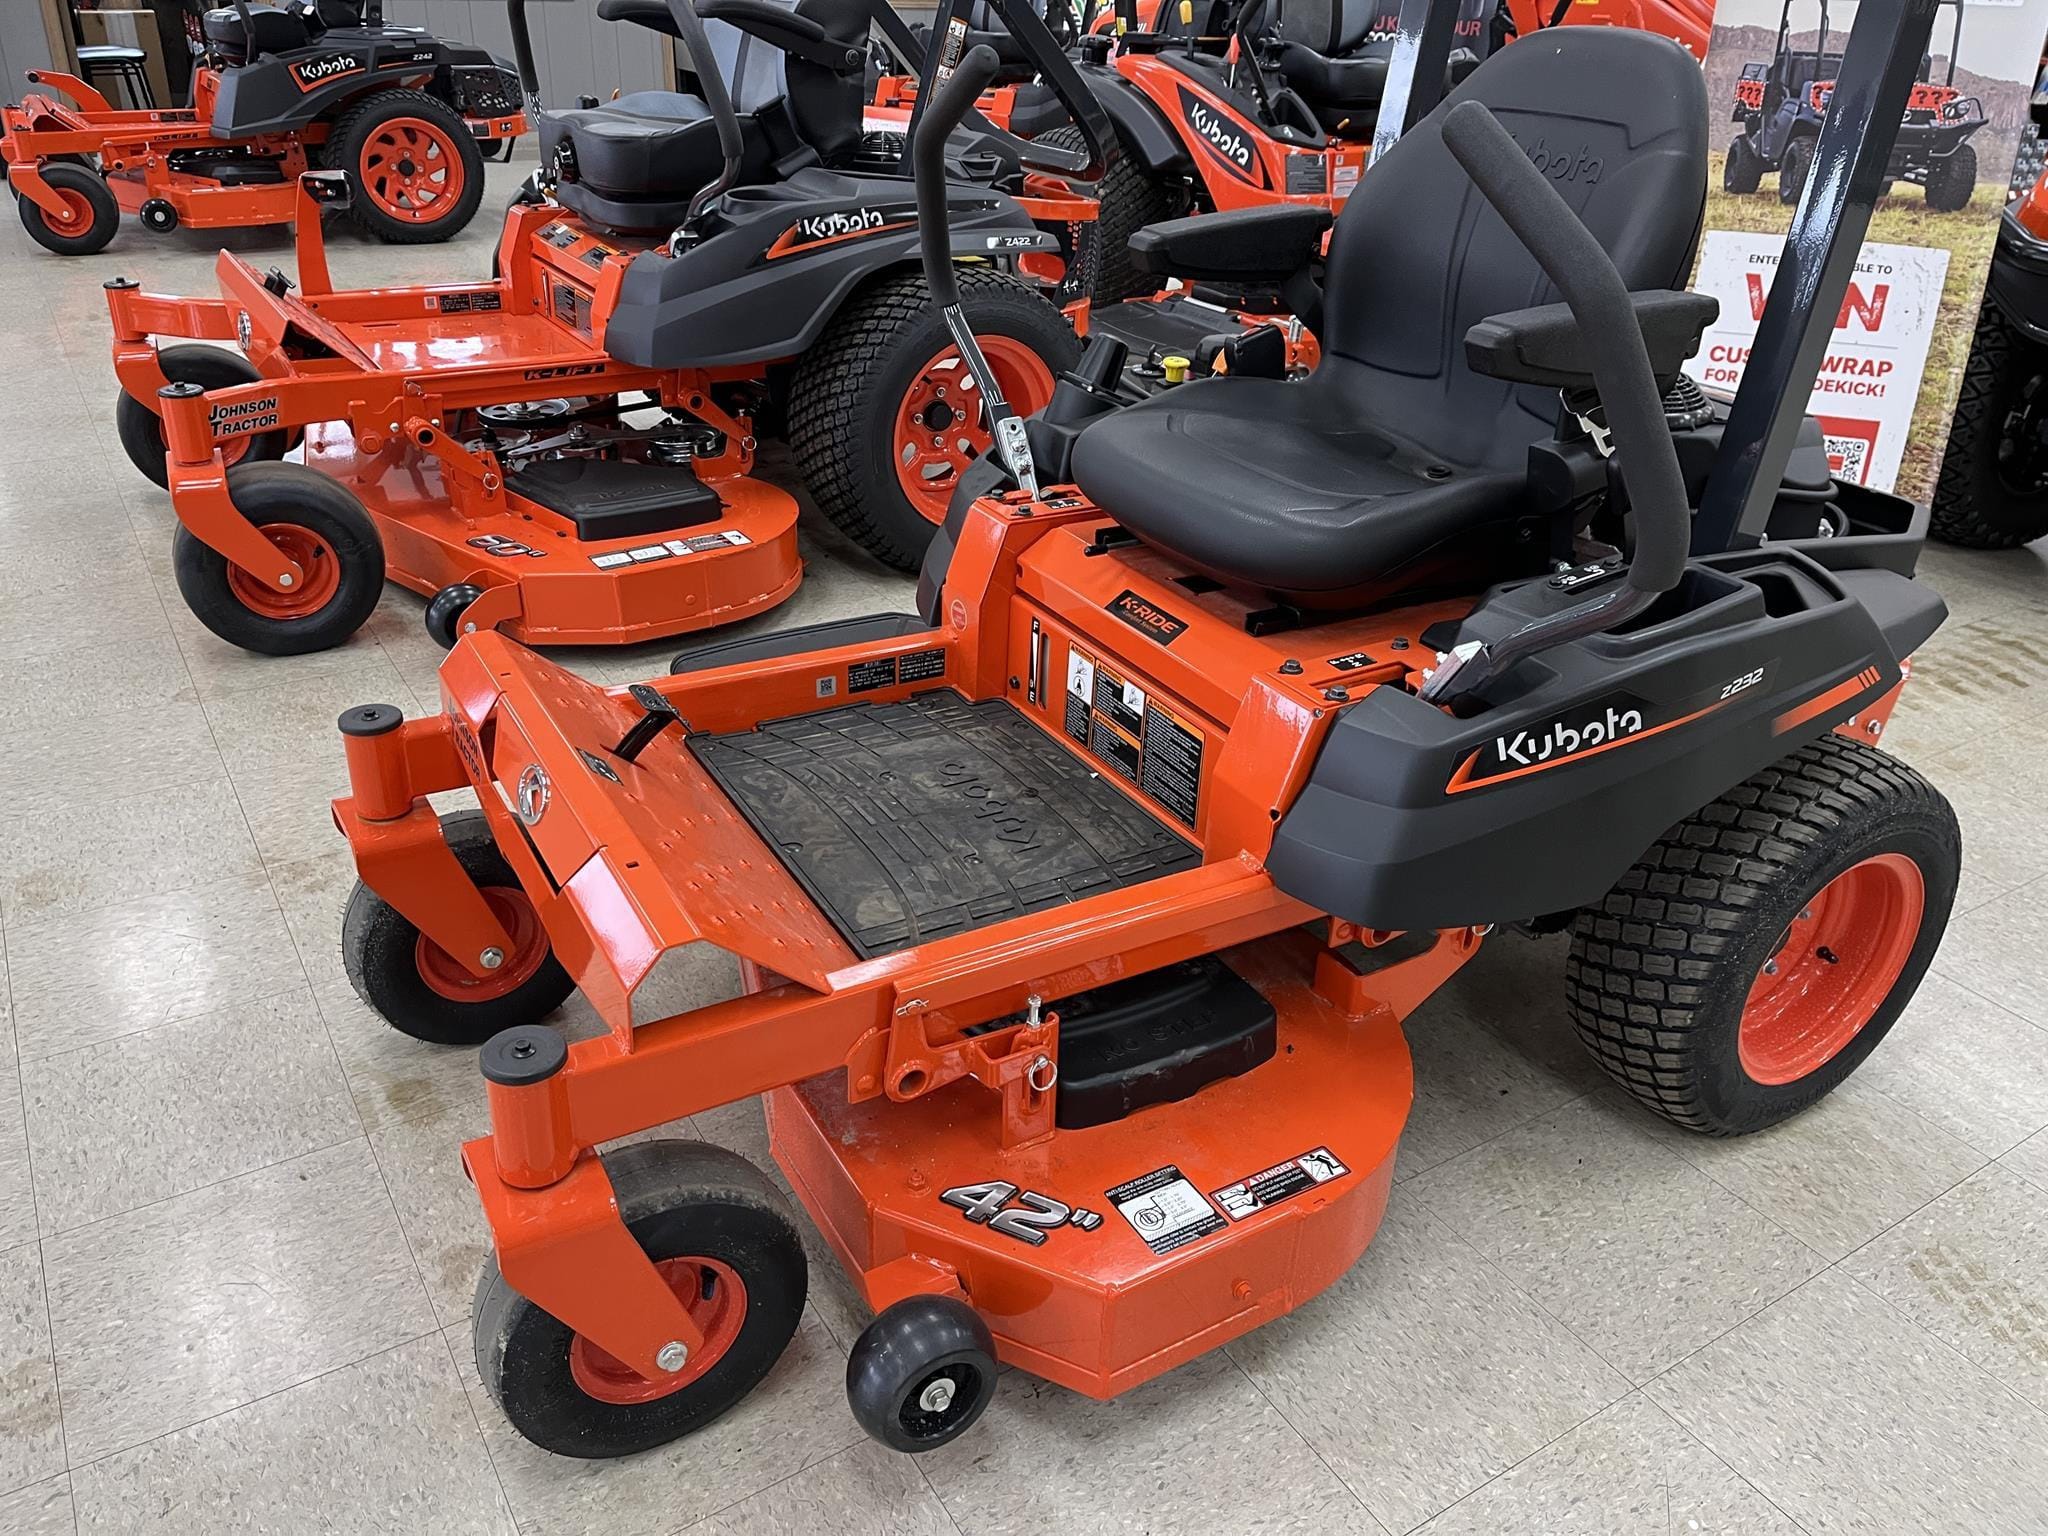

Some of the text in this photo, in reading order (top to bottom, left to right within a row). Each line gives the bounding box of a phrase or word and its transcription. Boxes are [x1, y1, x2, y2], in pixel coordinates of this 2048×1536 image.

[300, 56, 356, 79] Kubota
[1191, 102, 1249, 166] Kubota
[803, 208, 884, 238] Kubota
[1749, 254, 1780, 265] ENTE
[1877, 265, 1893, 275] TO
[526, 365, 599, 380] K-LIFT
[1821, 356, 1894, 378] WRAP
[1704, 368, 1886, 398] FOR DEKICK!
[208, 399, 277, 421] JOHNSON
[210, 414, 278, 437] TRACTOR
[1119, 597, 1180, 634] K-RIDE
[1720, 667, 1764, 700] Z232
[1496, 707, 1643, 765] Kubota
[938, 761, 1042, 856] Kubota
[1255, 1161, 1296, 1183] DANGER
[938, 1179, 1104, 1247] 42"
